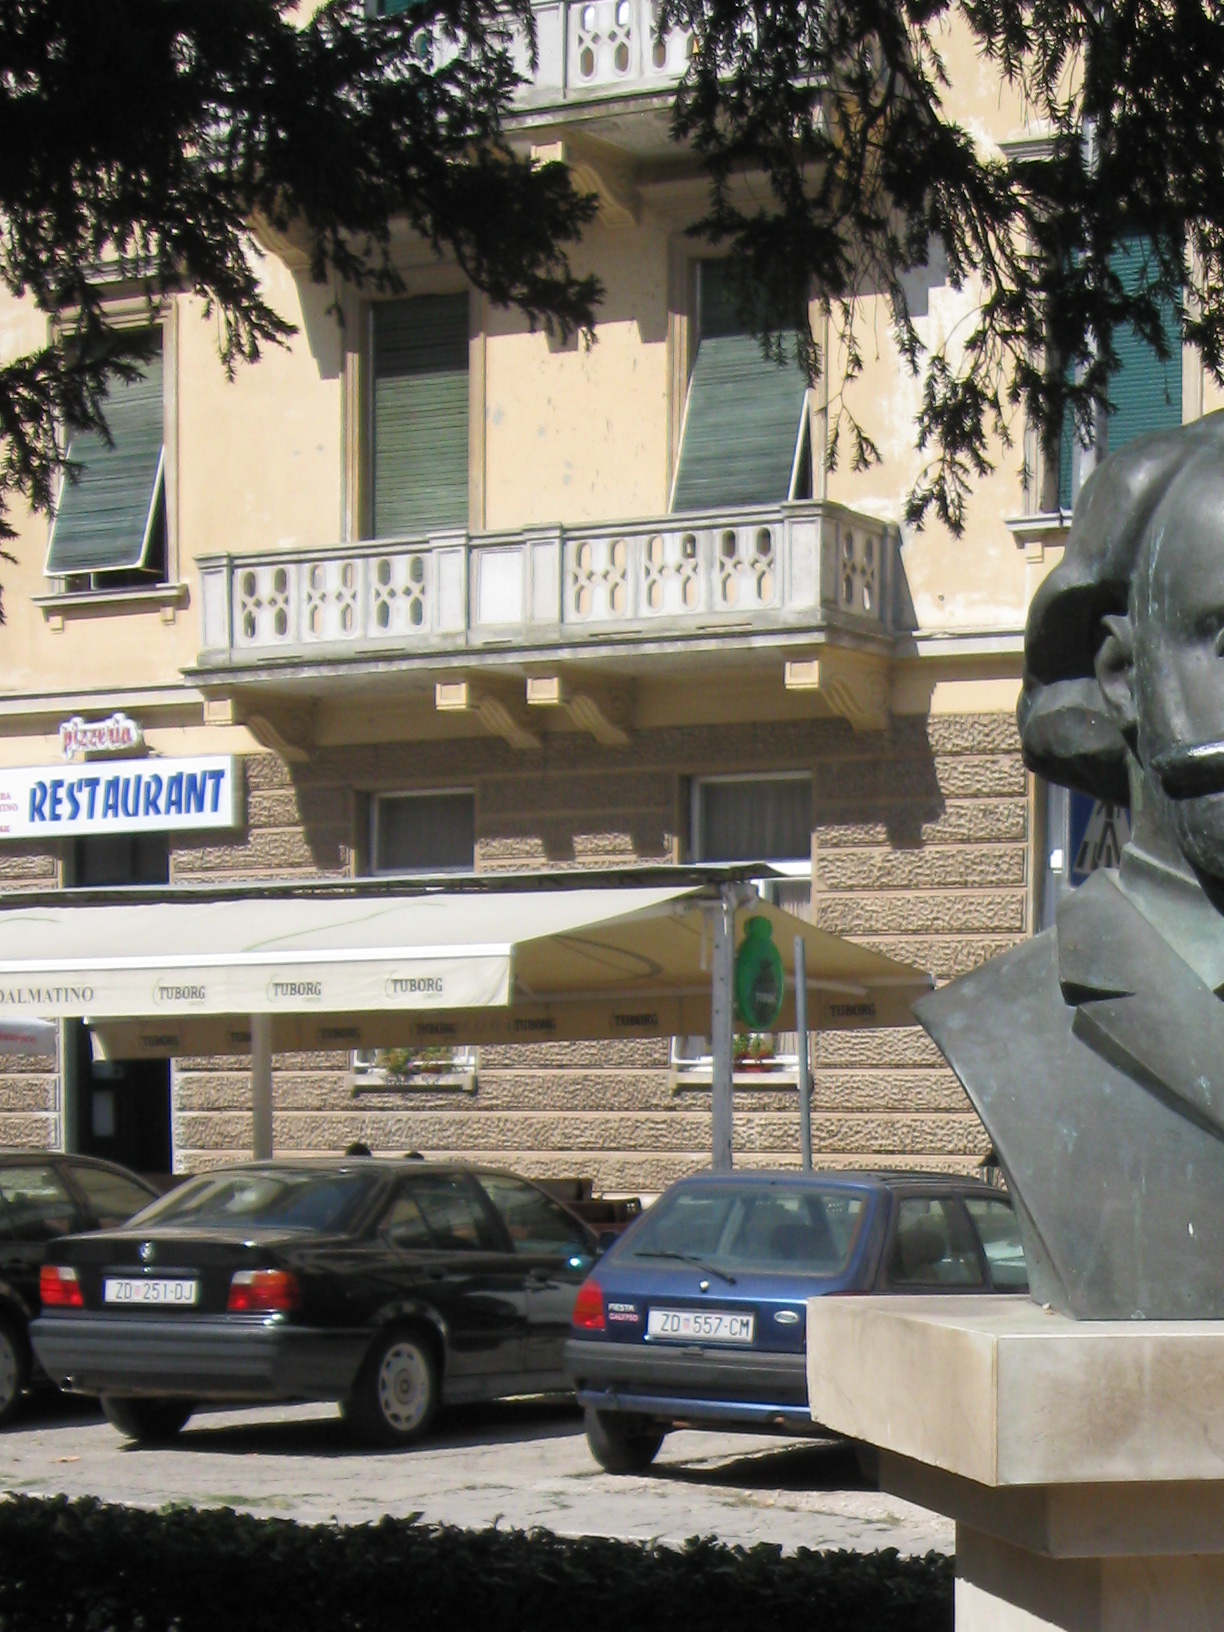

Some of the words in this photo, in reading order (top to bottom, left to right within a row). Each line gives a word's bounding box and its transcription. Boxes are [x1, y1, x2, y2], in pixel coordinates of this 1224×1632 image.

[62, 716, 133, 756] pizzeria
[29, 769, 225, 822] RESTAURANT
[158, 985, 206, 1000] TUBORG
[273, 982, 321, 996] TUBORG
[391, 978, 443, 992] TUBORG
[829, 1003, 876, 1017] TUBORG
[614, 1014, 659, 1026] TUBORG
[116, 1282, 132, 1299] ZD
[143, 1283, 193, 1301] 251-DJ
[660, 1313, 680, 1332] ZD
[693, 1315, 750, 1337] 557-CM
